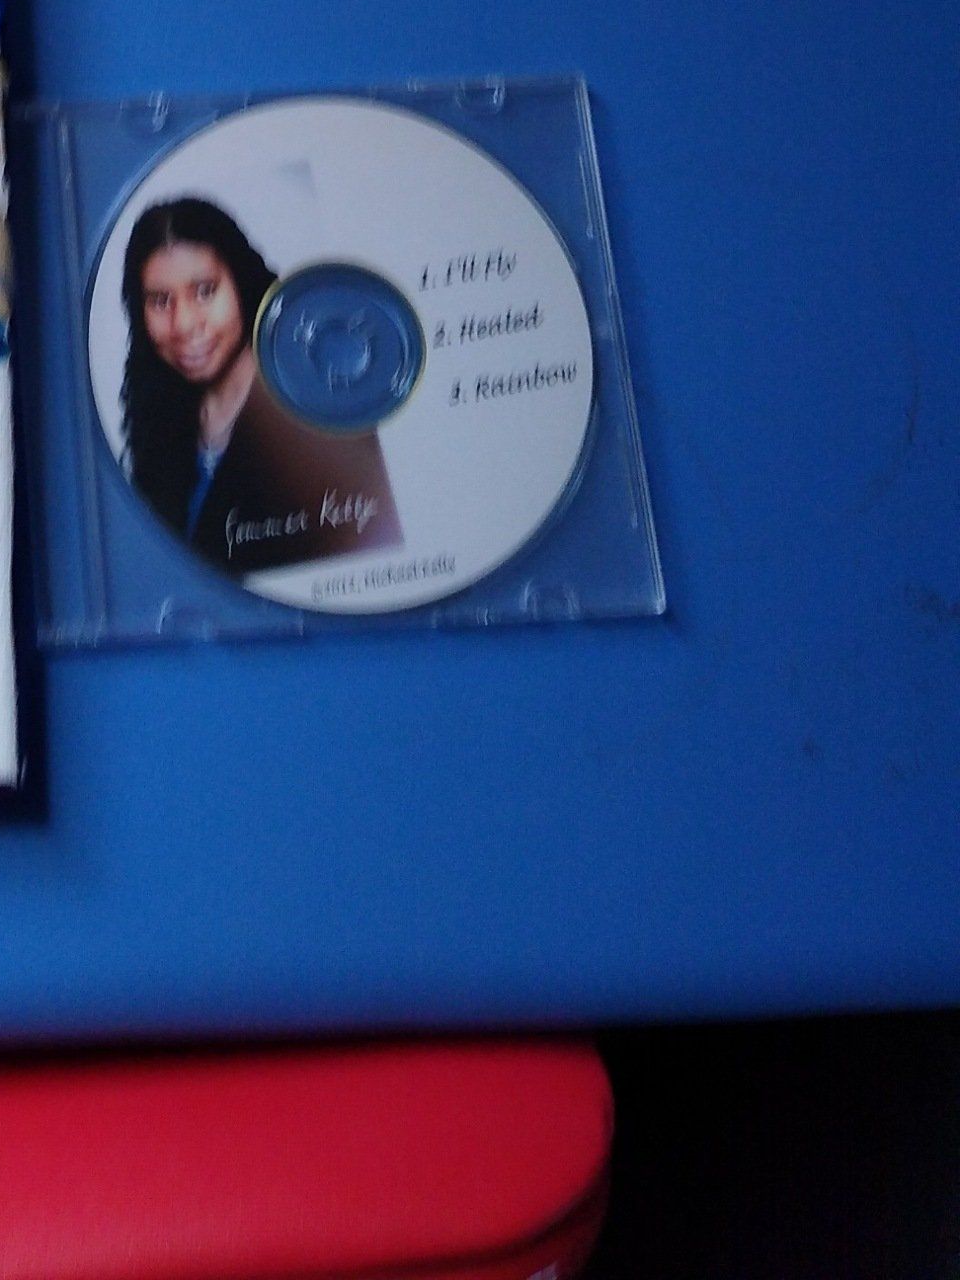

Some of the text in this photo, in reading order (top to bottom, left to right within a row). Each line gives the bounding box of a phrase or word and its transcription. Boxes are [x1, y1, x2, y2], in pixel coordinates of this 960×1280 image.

[419, 263, 437, 292] 1.
[483, 246, 517, 282] Fly
[433, 303, 544, 350] 2. Healed
[474, 362, 577, 403] Rainbow
